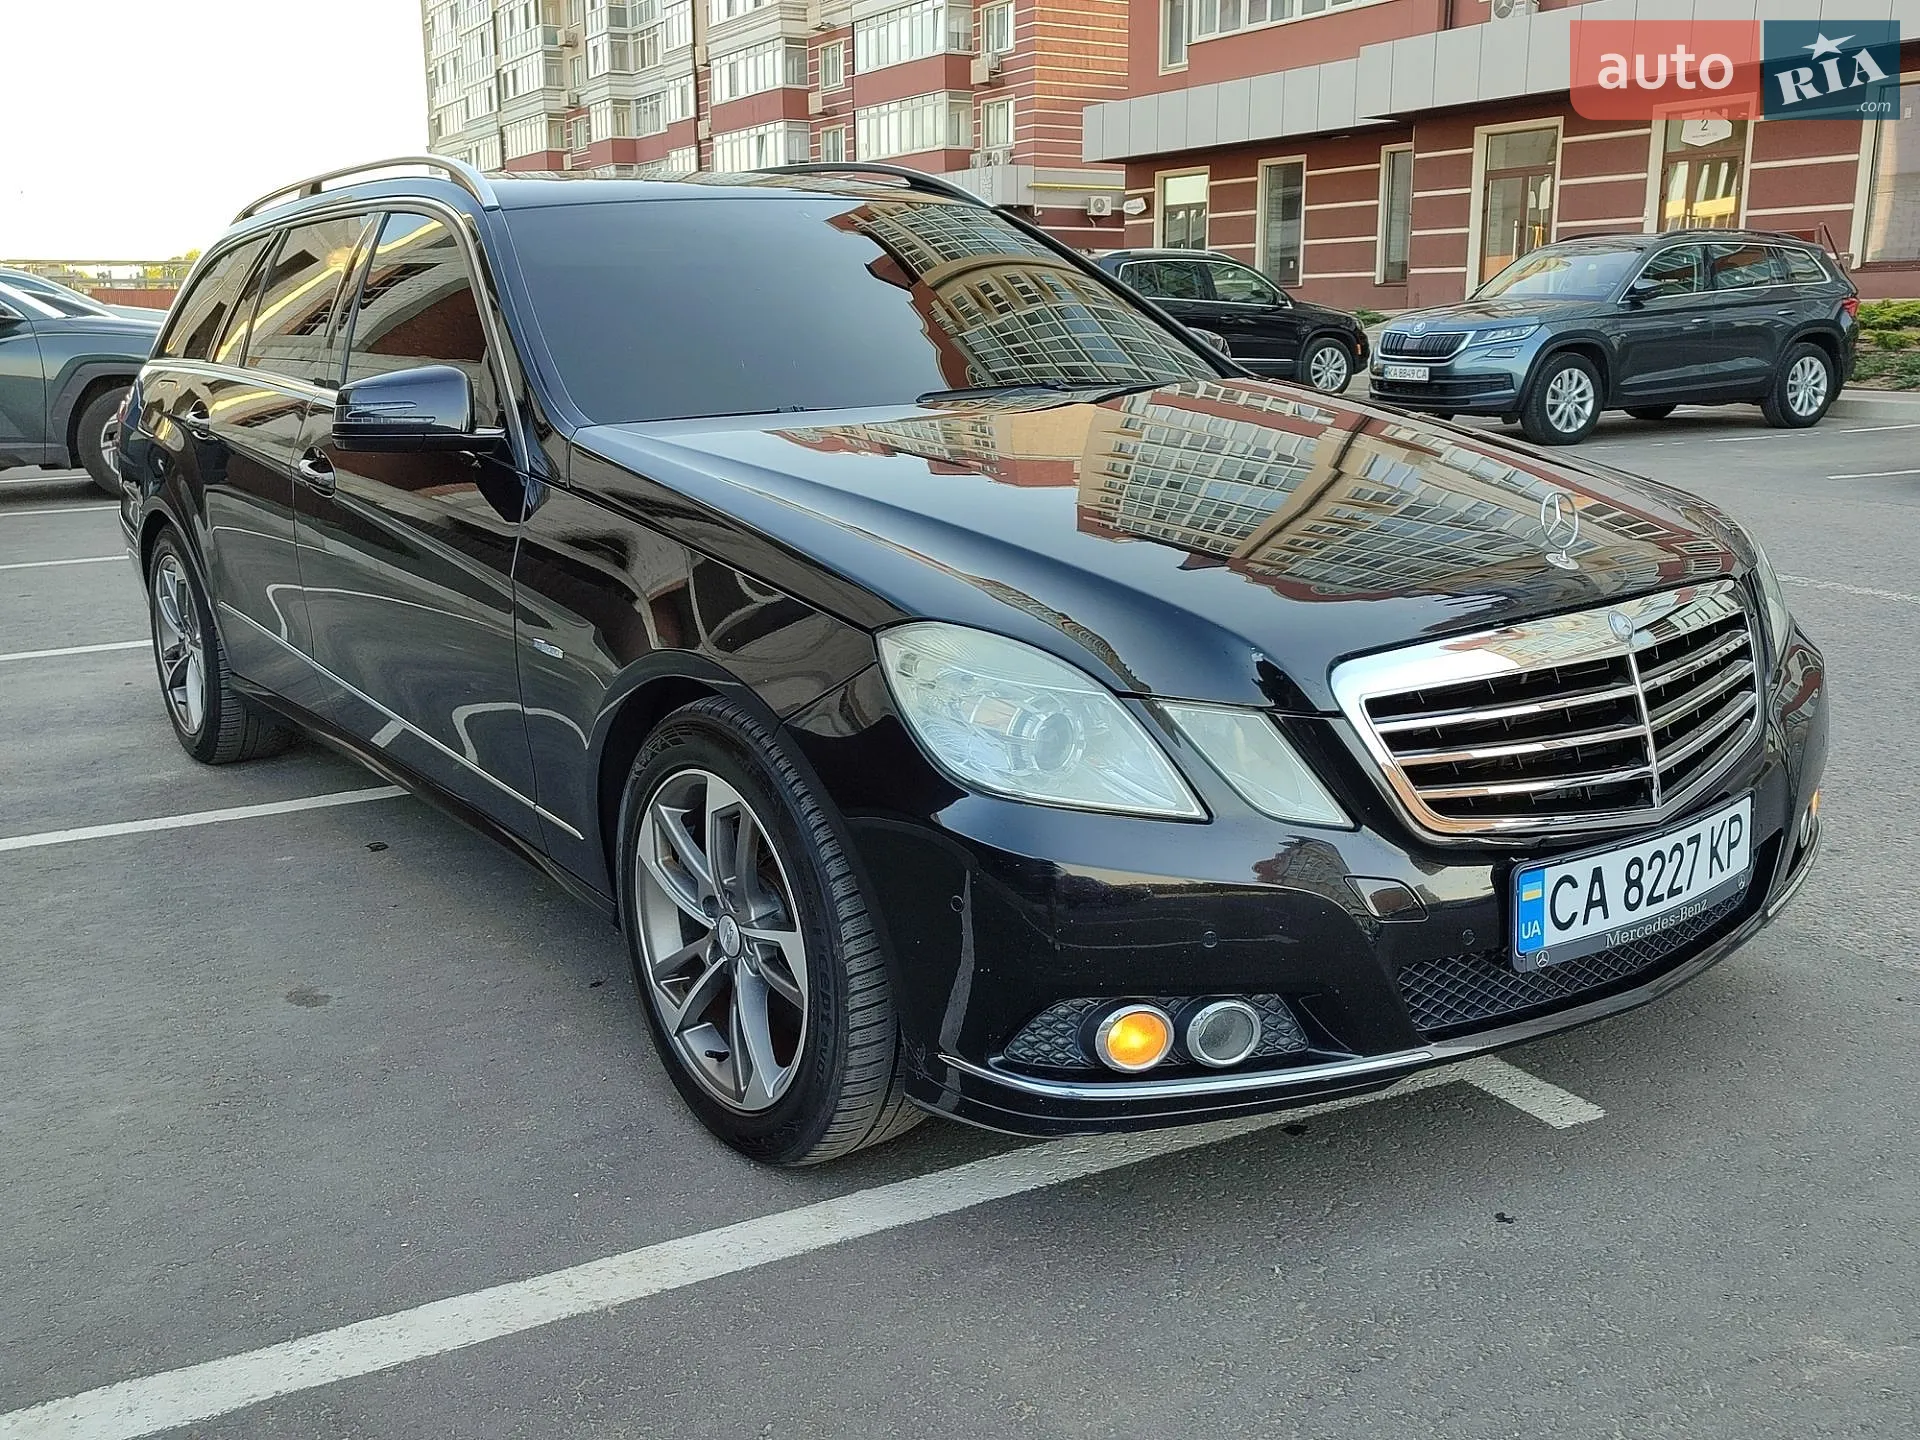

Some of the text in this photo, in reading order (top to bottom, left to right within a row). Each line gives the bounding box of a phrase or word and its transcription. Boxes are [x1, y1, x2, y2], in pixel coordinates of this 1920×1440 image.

[1701, 119, 1708, 131] 2
[1416, 369, 1427, 379] CA
[1549, 813, 1744, 932] CA 8227 KP
[1521, 919, 1542, 940] UA
[1604, 898, 1708, 949] Mercedes-Benz
